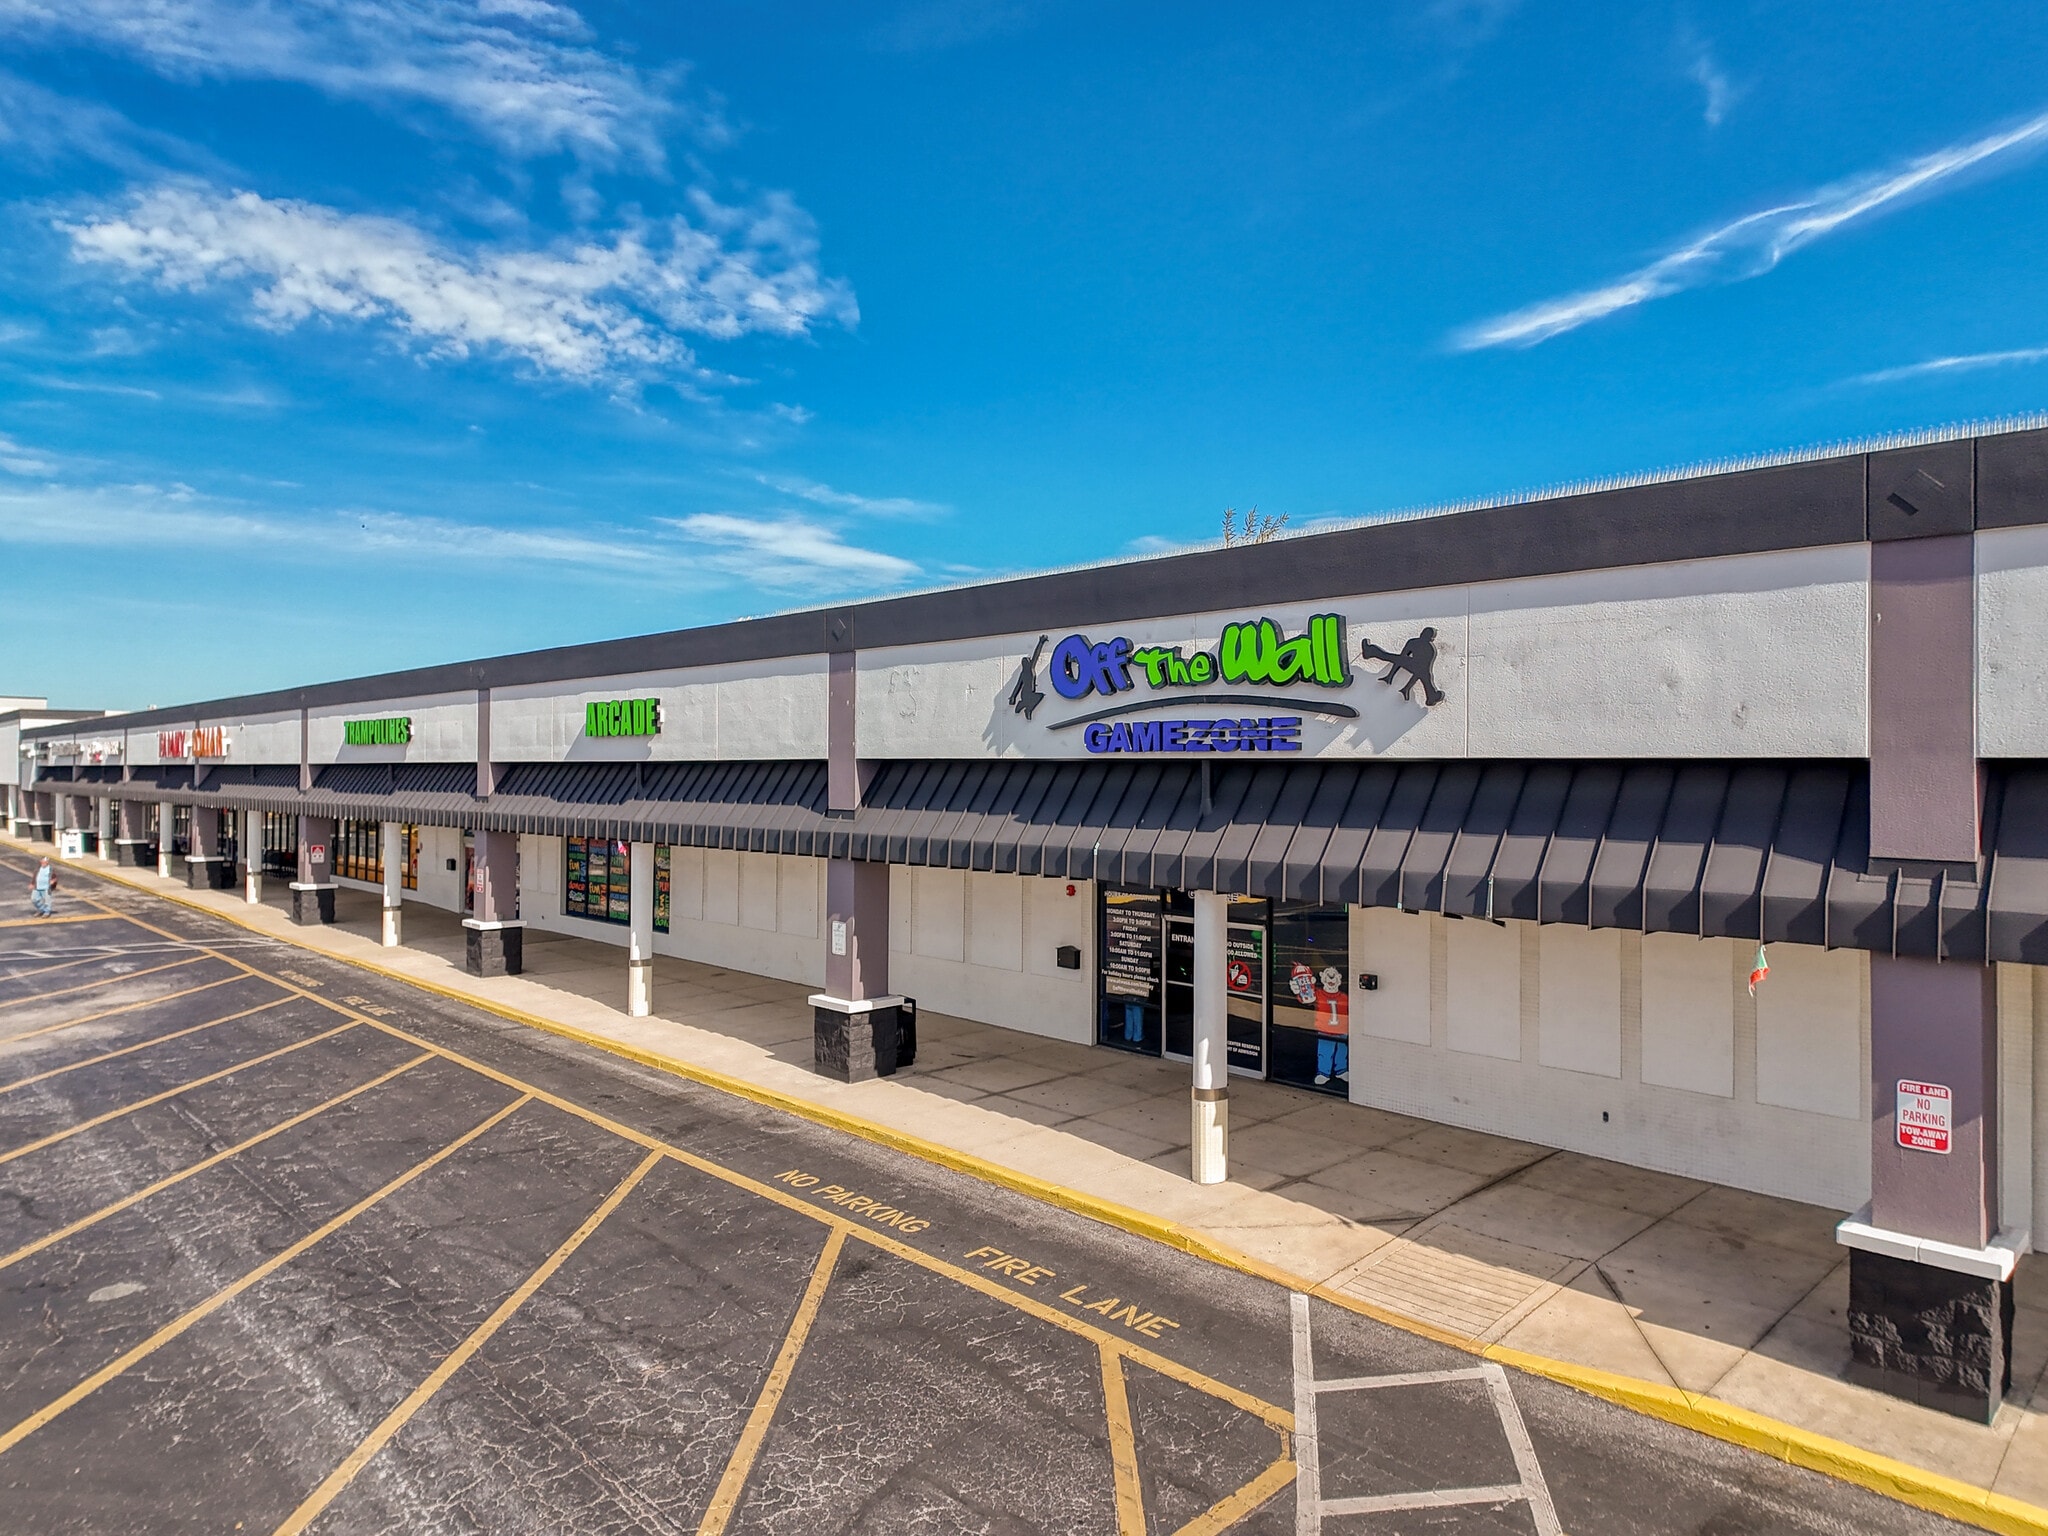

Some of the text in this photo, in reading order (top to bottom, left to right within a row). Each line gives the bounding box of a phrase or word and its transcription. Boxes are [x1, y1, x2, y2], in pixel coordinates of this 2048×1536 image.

[1050, 634, 1134, 699] Off
[1219, 613, 1354, 688] Wall
[585, 698, 661, 737] ARCADE
[344, 717, 411, 745] TRAMPOLINES
[1084, 717, 1303, 753] GAMEZONE
[1171, 934, 1194, 943] ENTRAN
[1901, 1083, 1946, 1097] FIRE LANE
[1916, 1098, 1931, 1110] NO
[1903, 1110, 1945, 1126] PARKING
[1900, 1125, 1947, 1141] TOW-AWAY
[1911, 1136, 1936, 1148] ZONE
[774, 1169, 931, 1233] NO PARKING
[964, 1246, 1180, 1339] FIRE LANE
